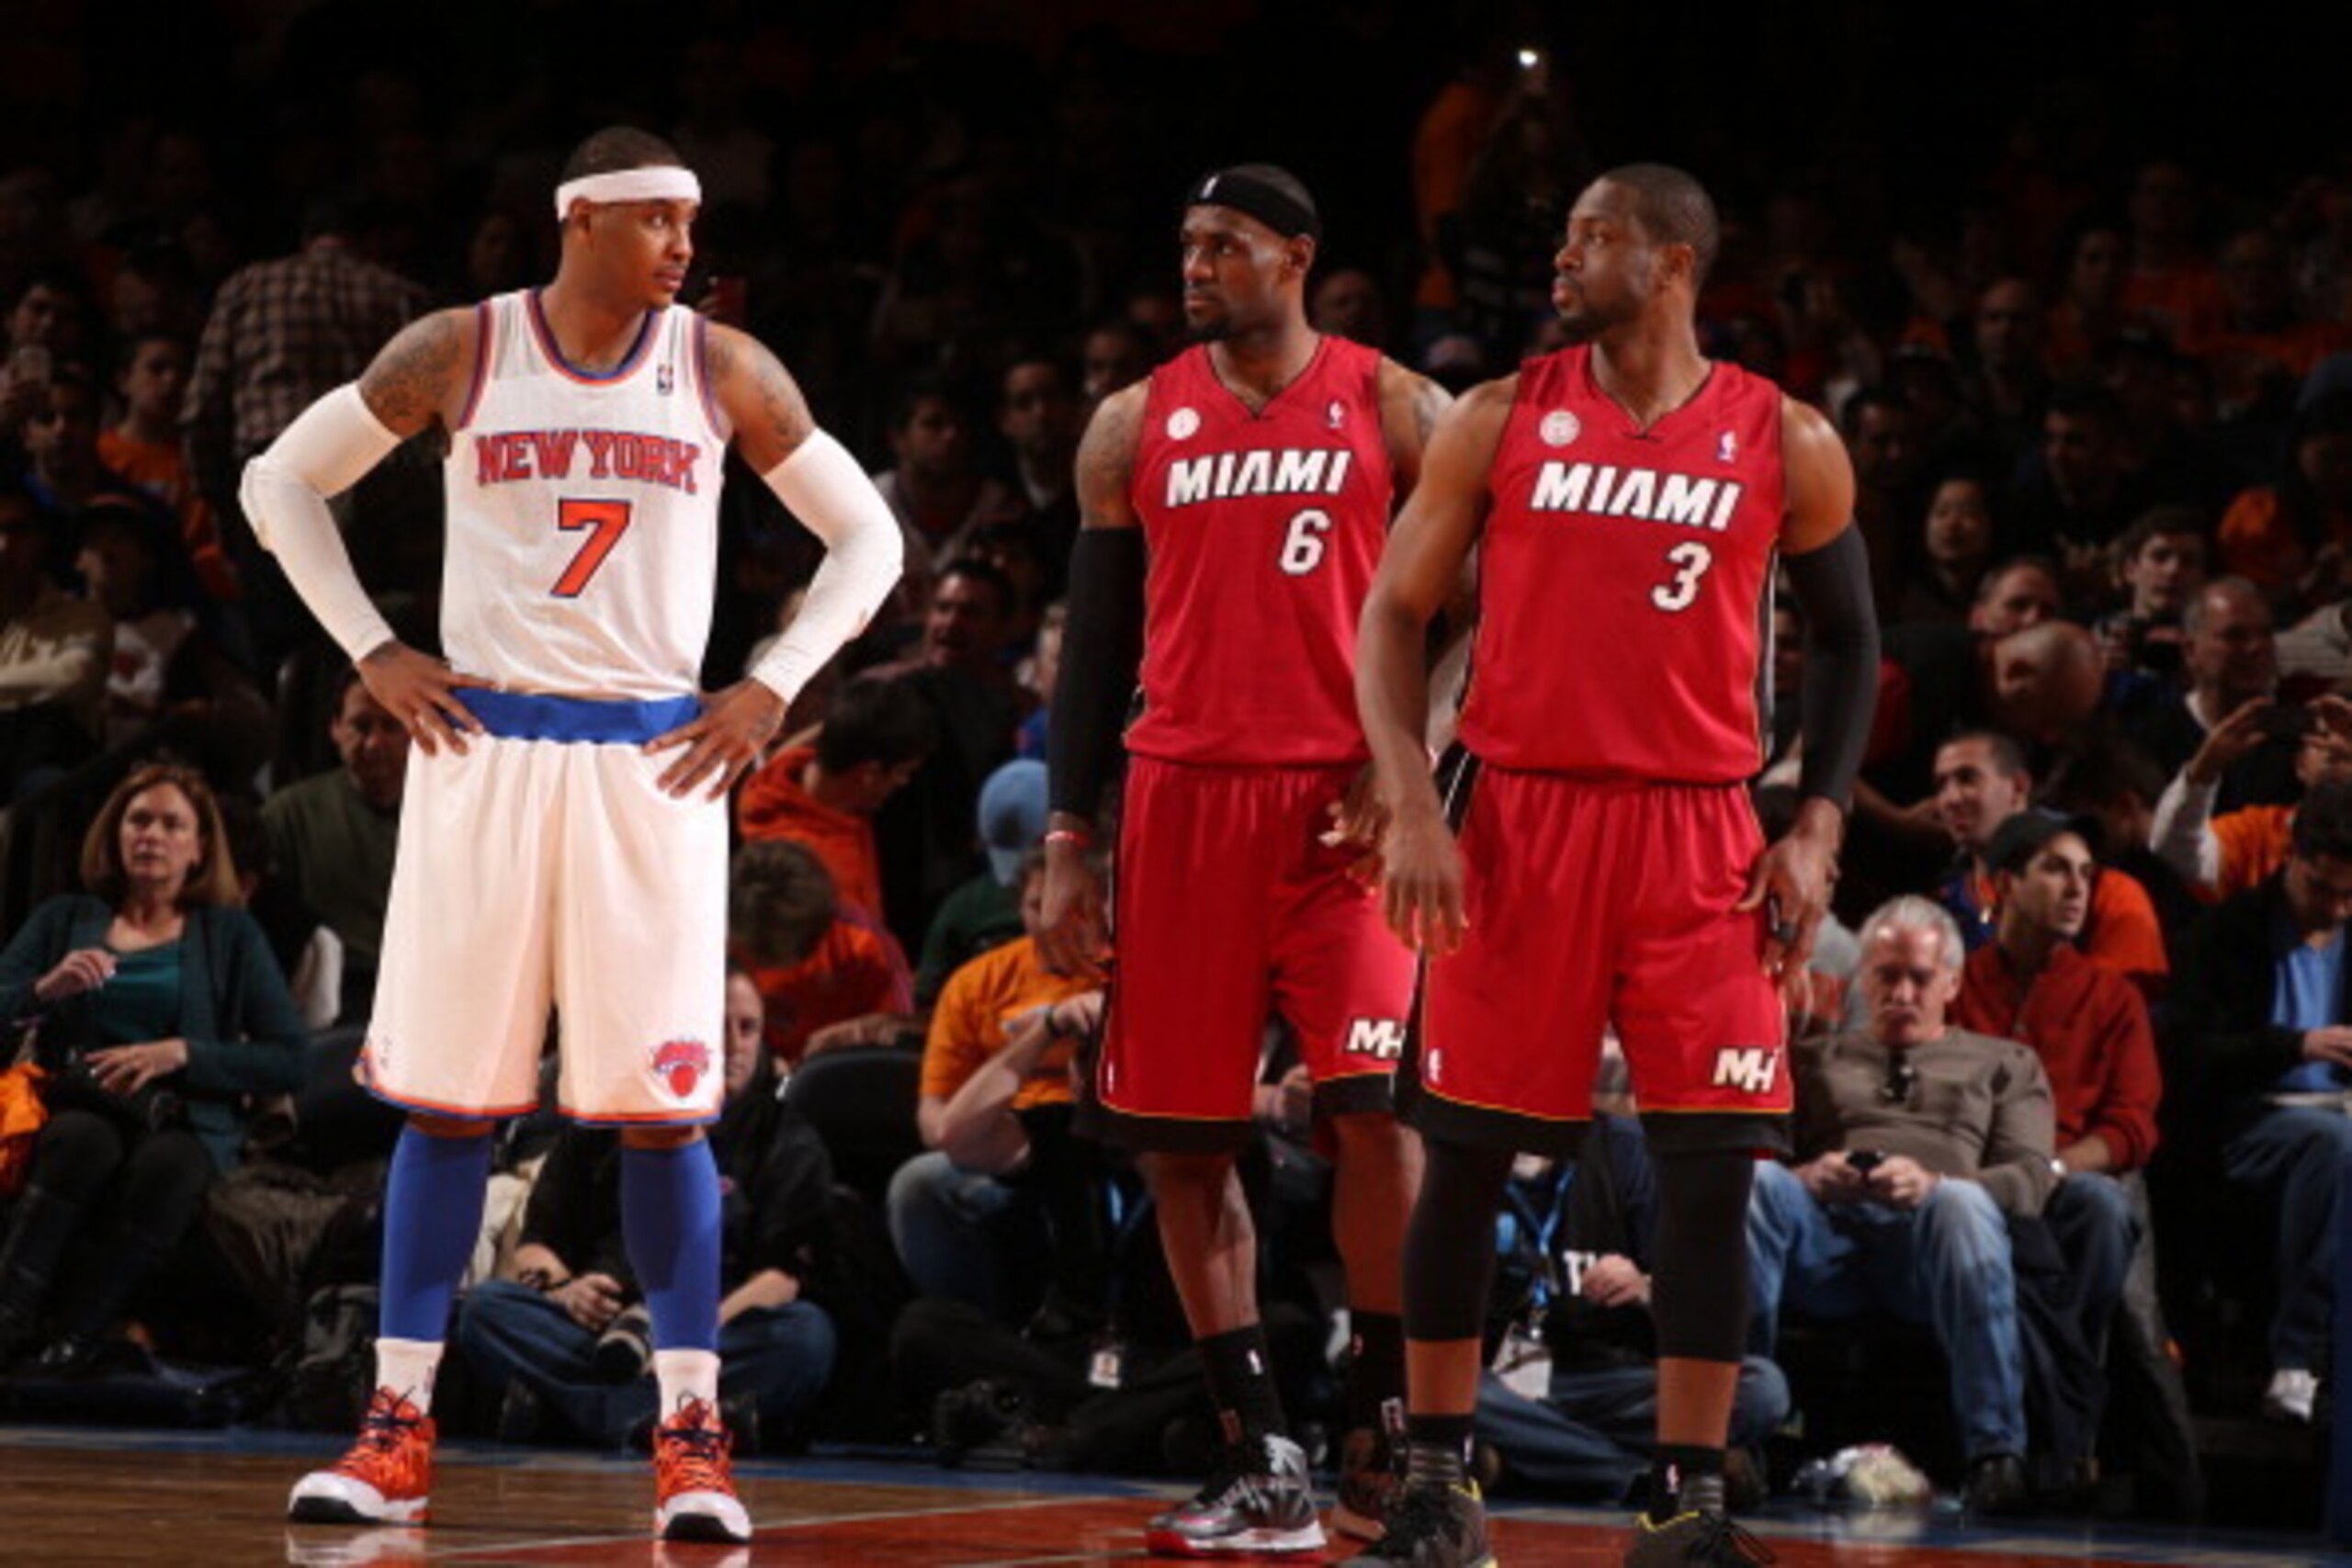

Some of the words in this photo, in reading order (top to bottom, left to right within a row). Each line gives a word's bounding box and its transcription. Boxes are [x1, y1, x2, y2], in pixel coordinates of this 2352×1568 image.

[475, 429, 579, 487] NEW
[581, 430, 701, 494] YORK
[1163, 447, 1353, 510] MIAMI
[1528, 459, 1745, 532] MIAMI
[550, 499, 631, 598] 7
[1278, 507, 1332, 577] 6
[1648, 539, 1713, 613] 3
